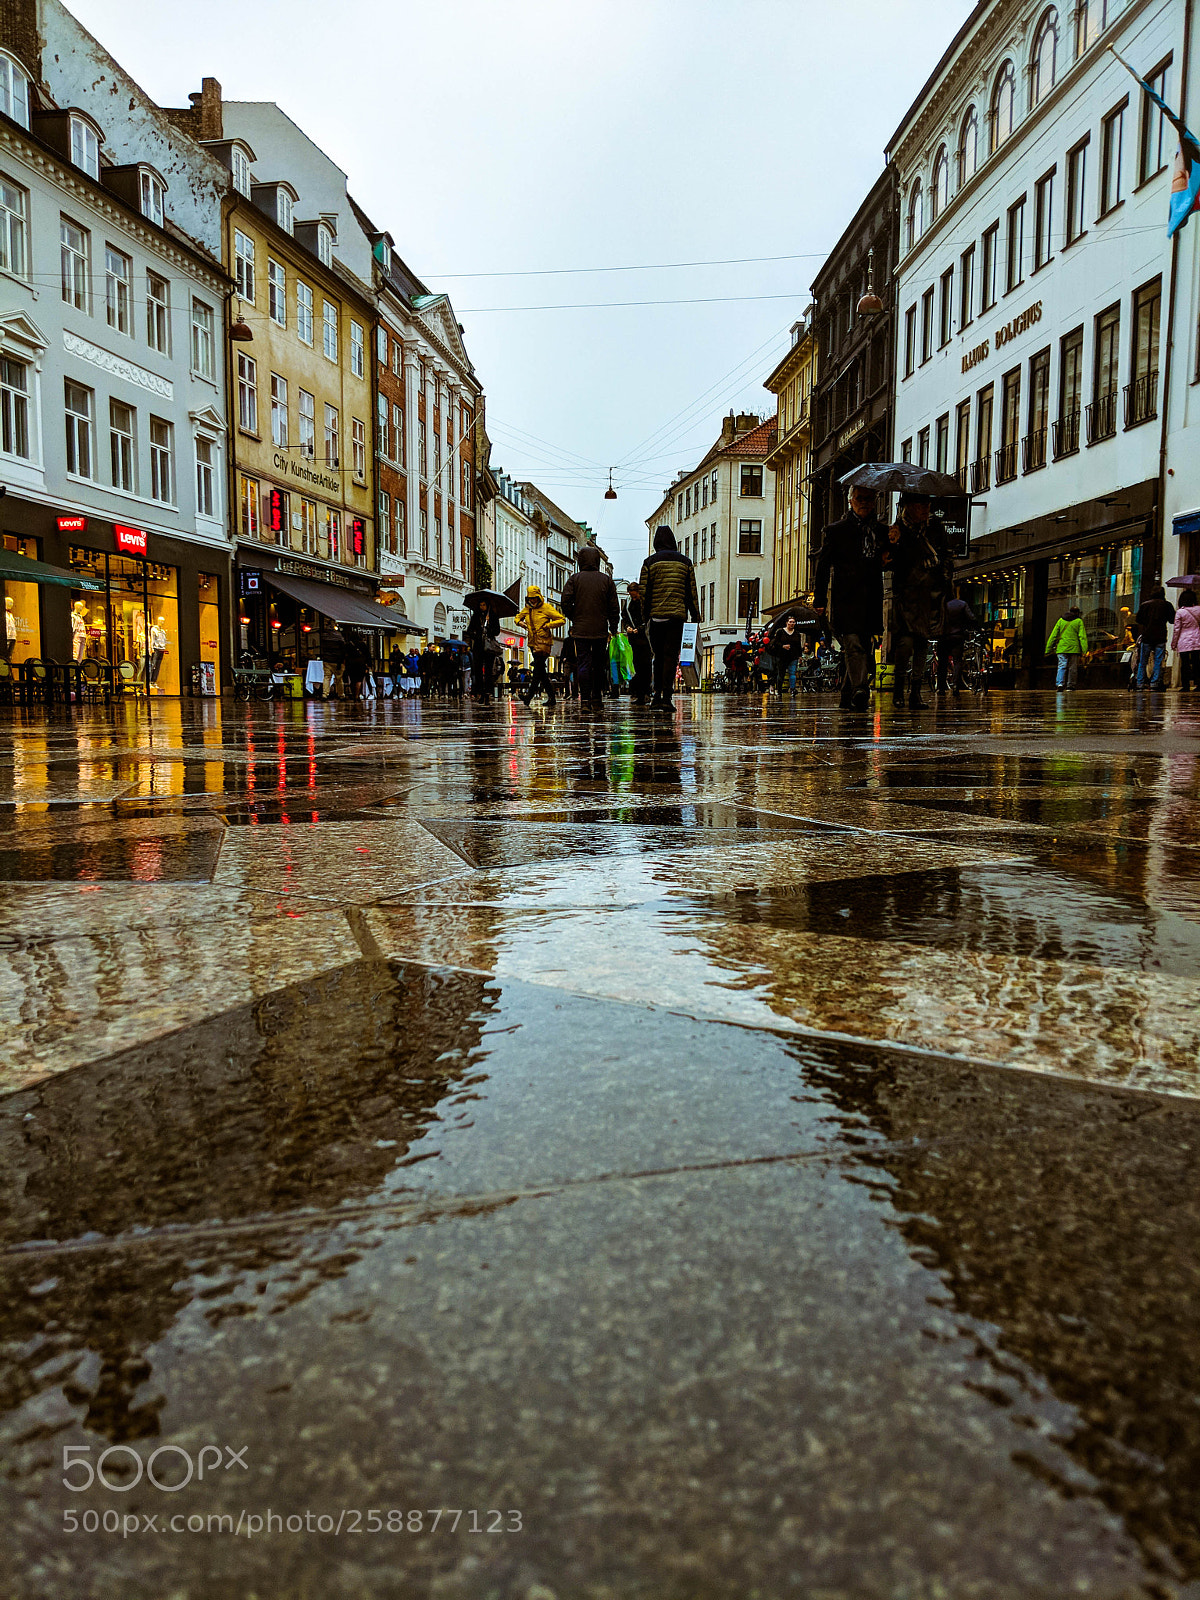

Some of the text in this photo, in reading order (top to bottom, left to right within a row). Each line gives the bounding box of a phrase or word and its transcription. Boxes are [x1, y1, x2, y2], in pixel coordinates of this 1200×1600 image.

[961, 300, 1043, 374] ILLUMS BOLIGHUS
[273, 453, 288, 475] City
